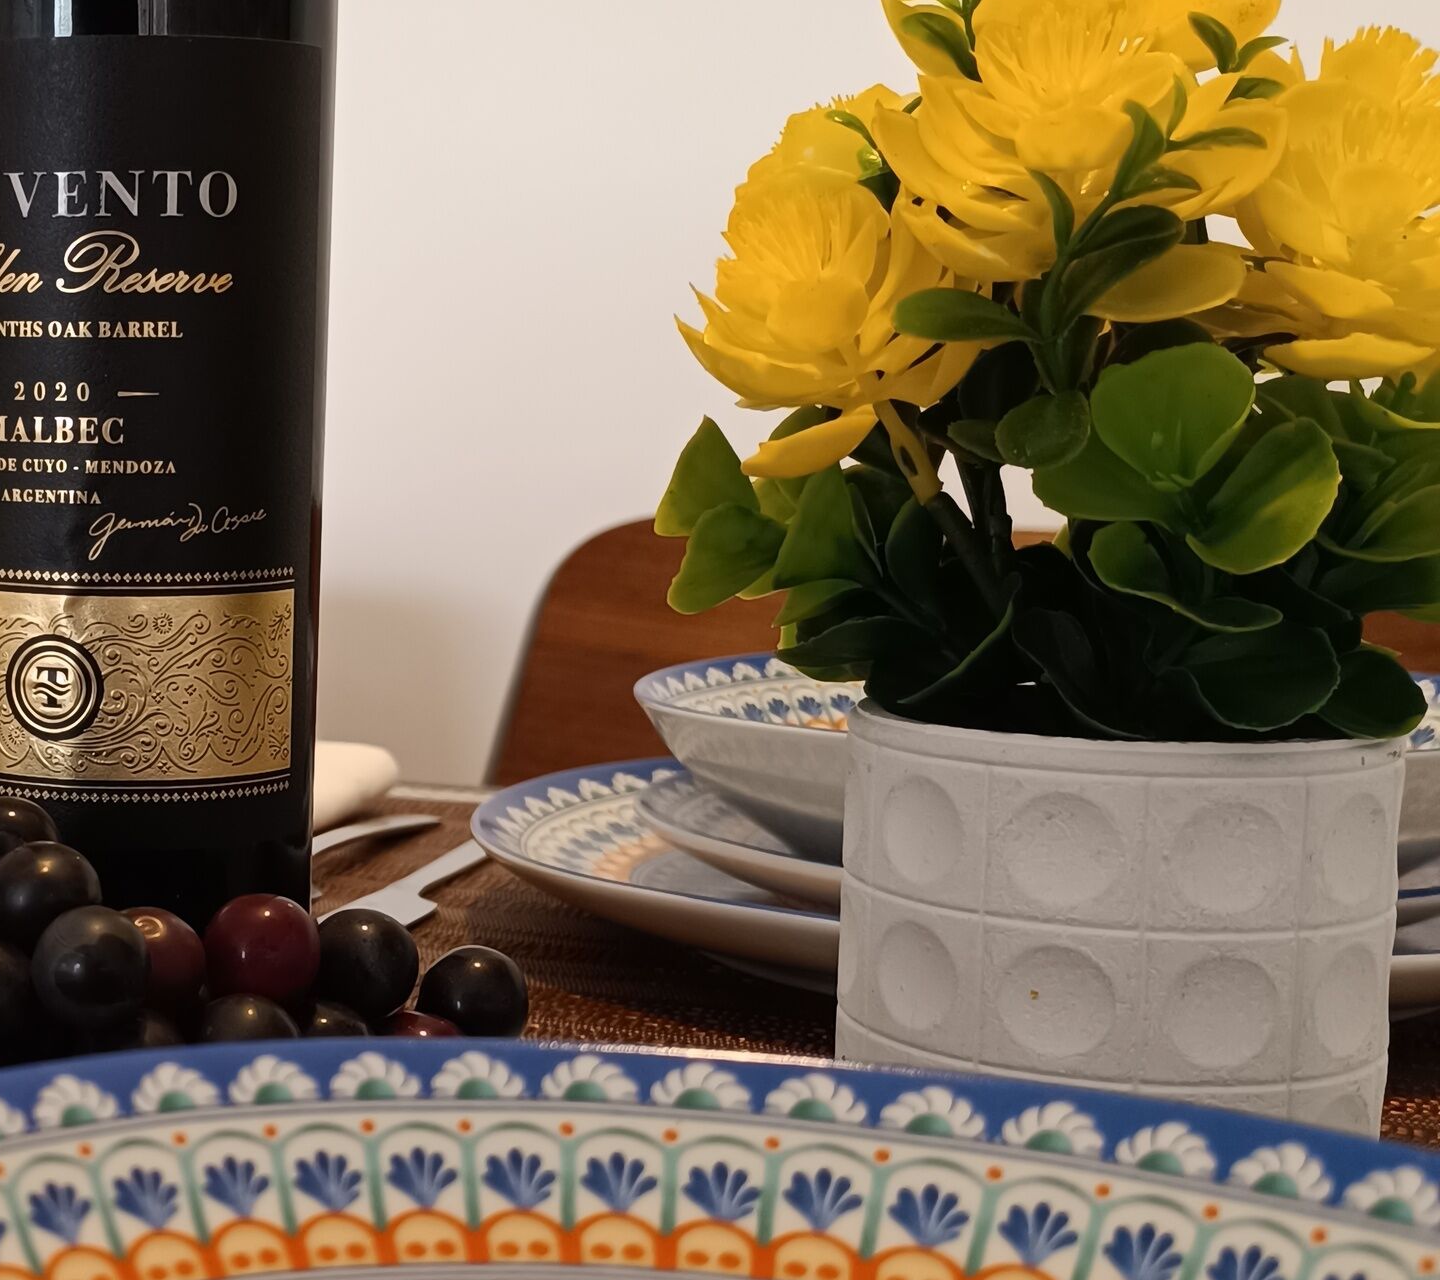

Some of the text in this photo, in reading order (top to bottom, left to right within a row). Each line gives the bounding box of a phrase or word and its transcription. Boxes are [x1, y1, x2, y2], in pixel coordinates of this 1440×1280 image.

[56, 230, 234, 295] Reserve
[47, 320, 93, 338] OAK
[98, 321, 184, 339] BARREL
[22, 458, 68, 474] CUYO
[84, 459, 177, 475] MENDOZA
[0, 488, 102, 505] ARGENTINA
